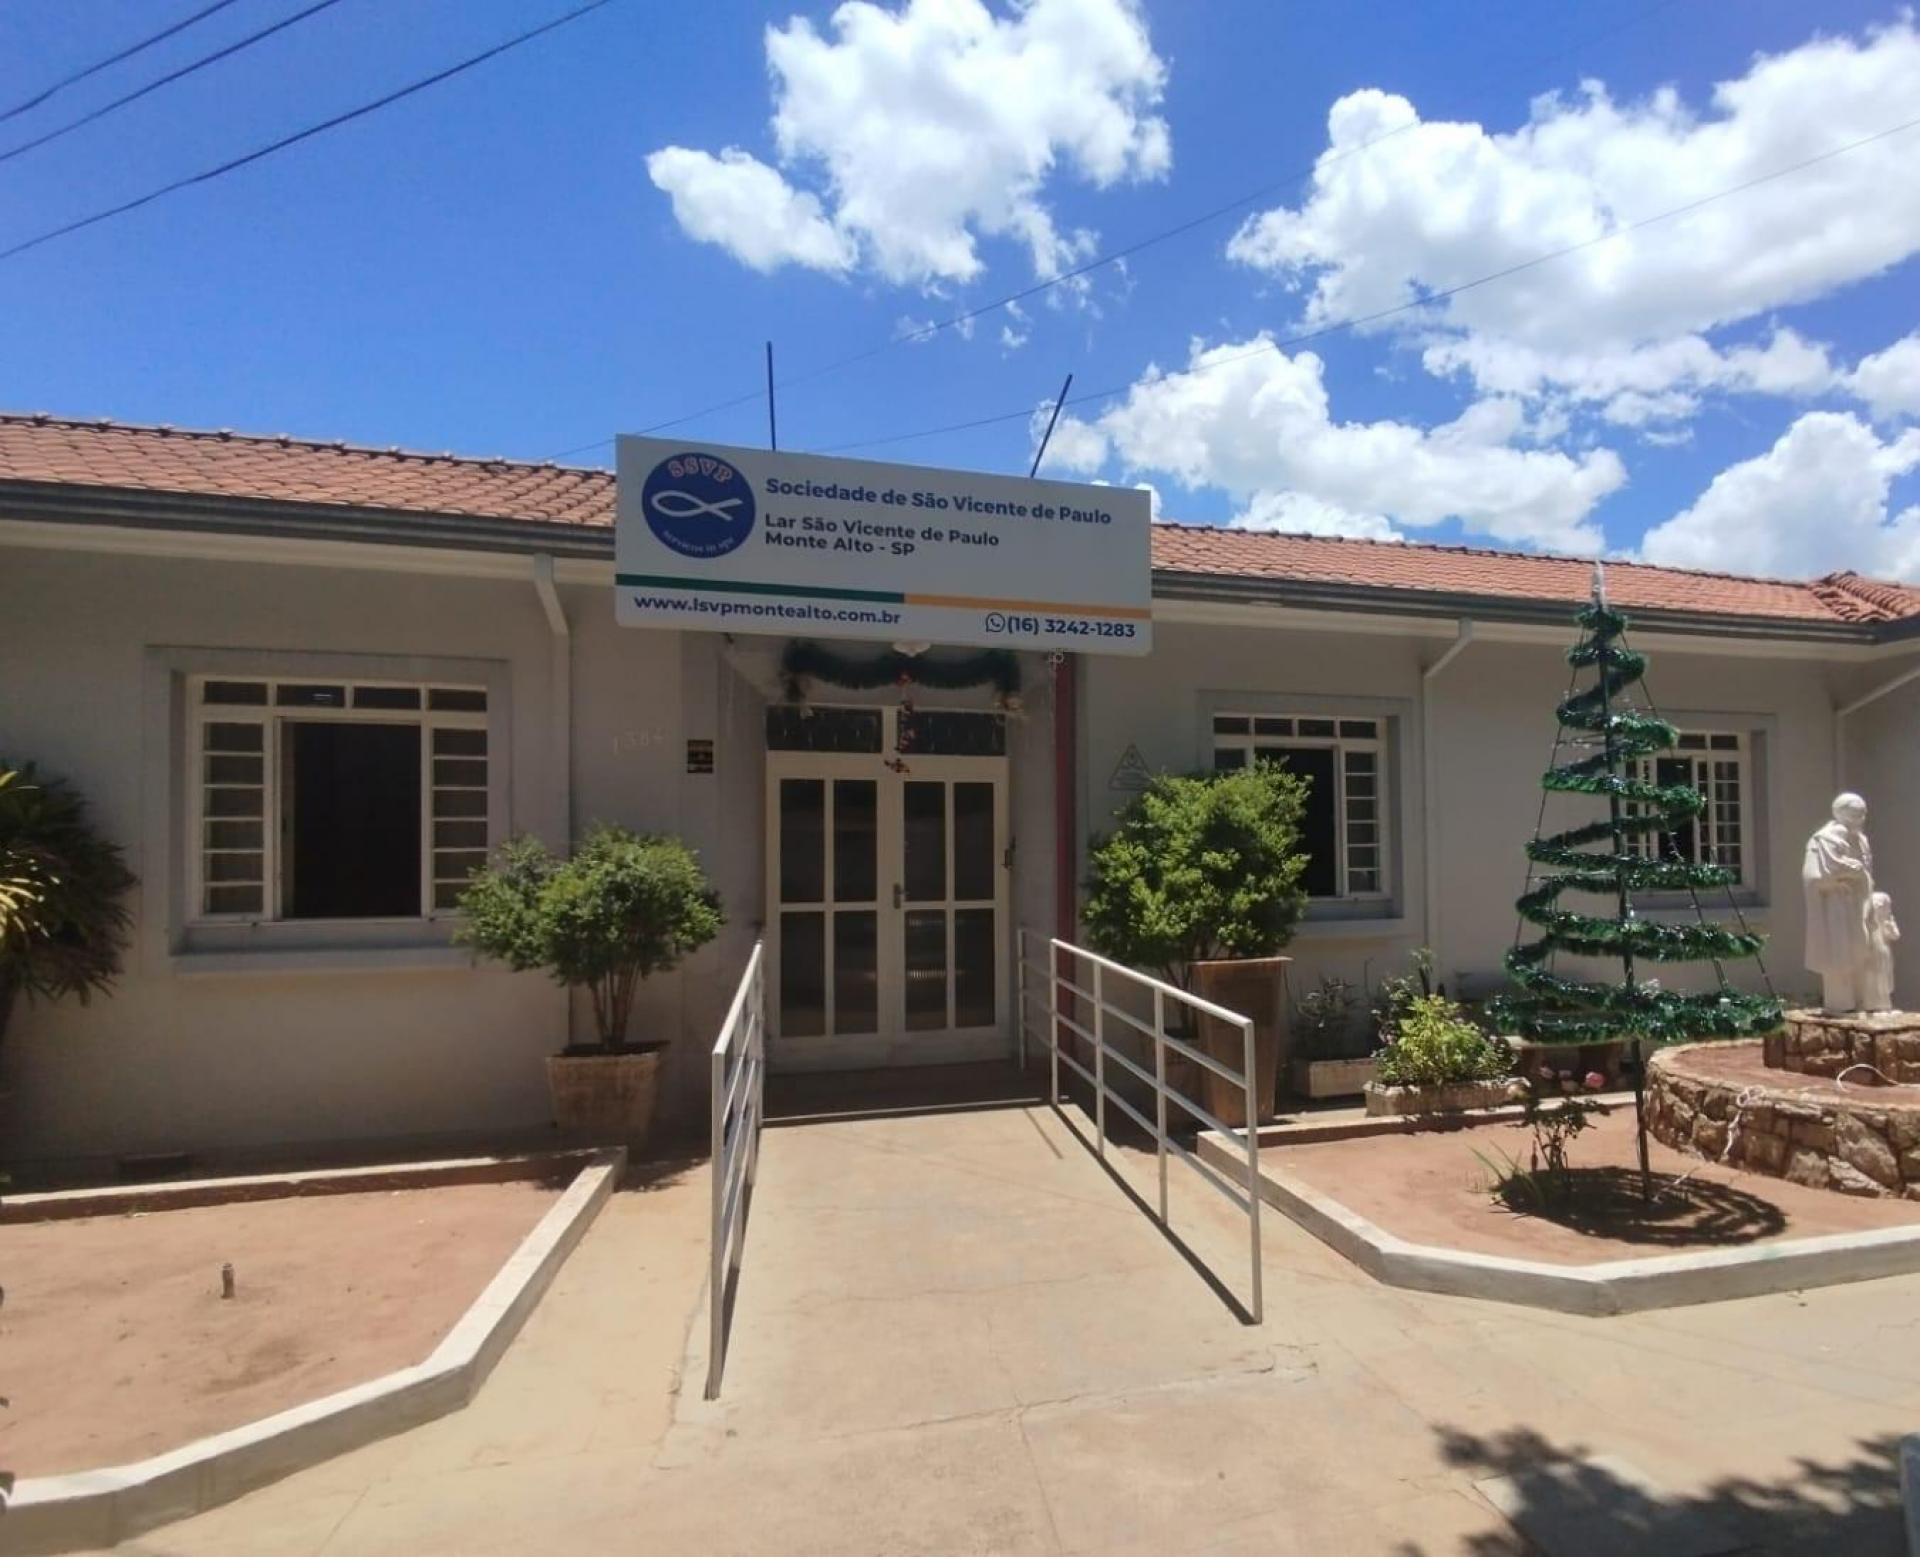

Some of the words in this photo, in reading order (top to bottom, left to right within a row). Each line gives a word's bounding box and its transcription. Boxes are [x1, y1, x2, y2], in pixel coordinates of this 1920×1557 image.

[667, 456, 733, 484] SSVP
[765, 477, 877, 504] Sociedade
[881, 488, 906, 506] de
[911, 491, 949, 510] São
[953, 495, 1027, 518] Vicente
[1032, 501, 1055, 520] de
[1059, 506, 1112, 525] Paulo
[765, 513, 796, 529] Lar
[802, 514, 838, 532] São
[843, 518, 915, 539] Vicente
[921, 526, 944, 542] de
[949, 529, 1000, 546] Paulo
[765, 531, 828, 550] Monte
[834, 536, 874, 553] Alto
[891, 542, 916, 557] SP
[634, 596, 901, 625] www.lsvpmontealto.com.br
[1007, 615, 1040, 636] (16)
[1044, 618, 1136, 638] 3242-1283
